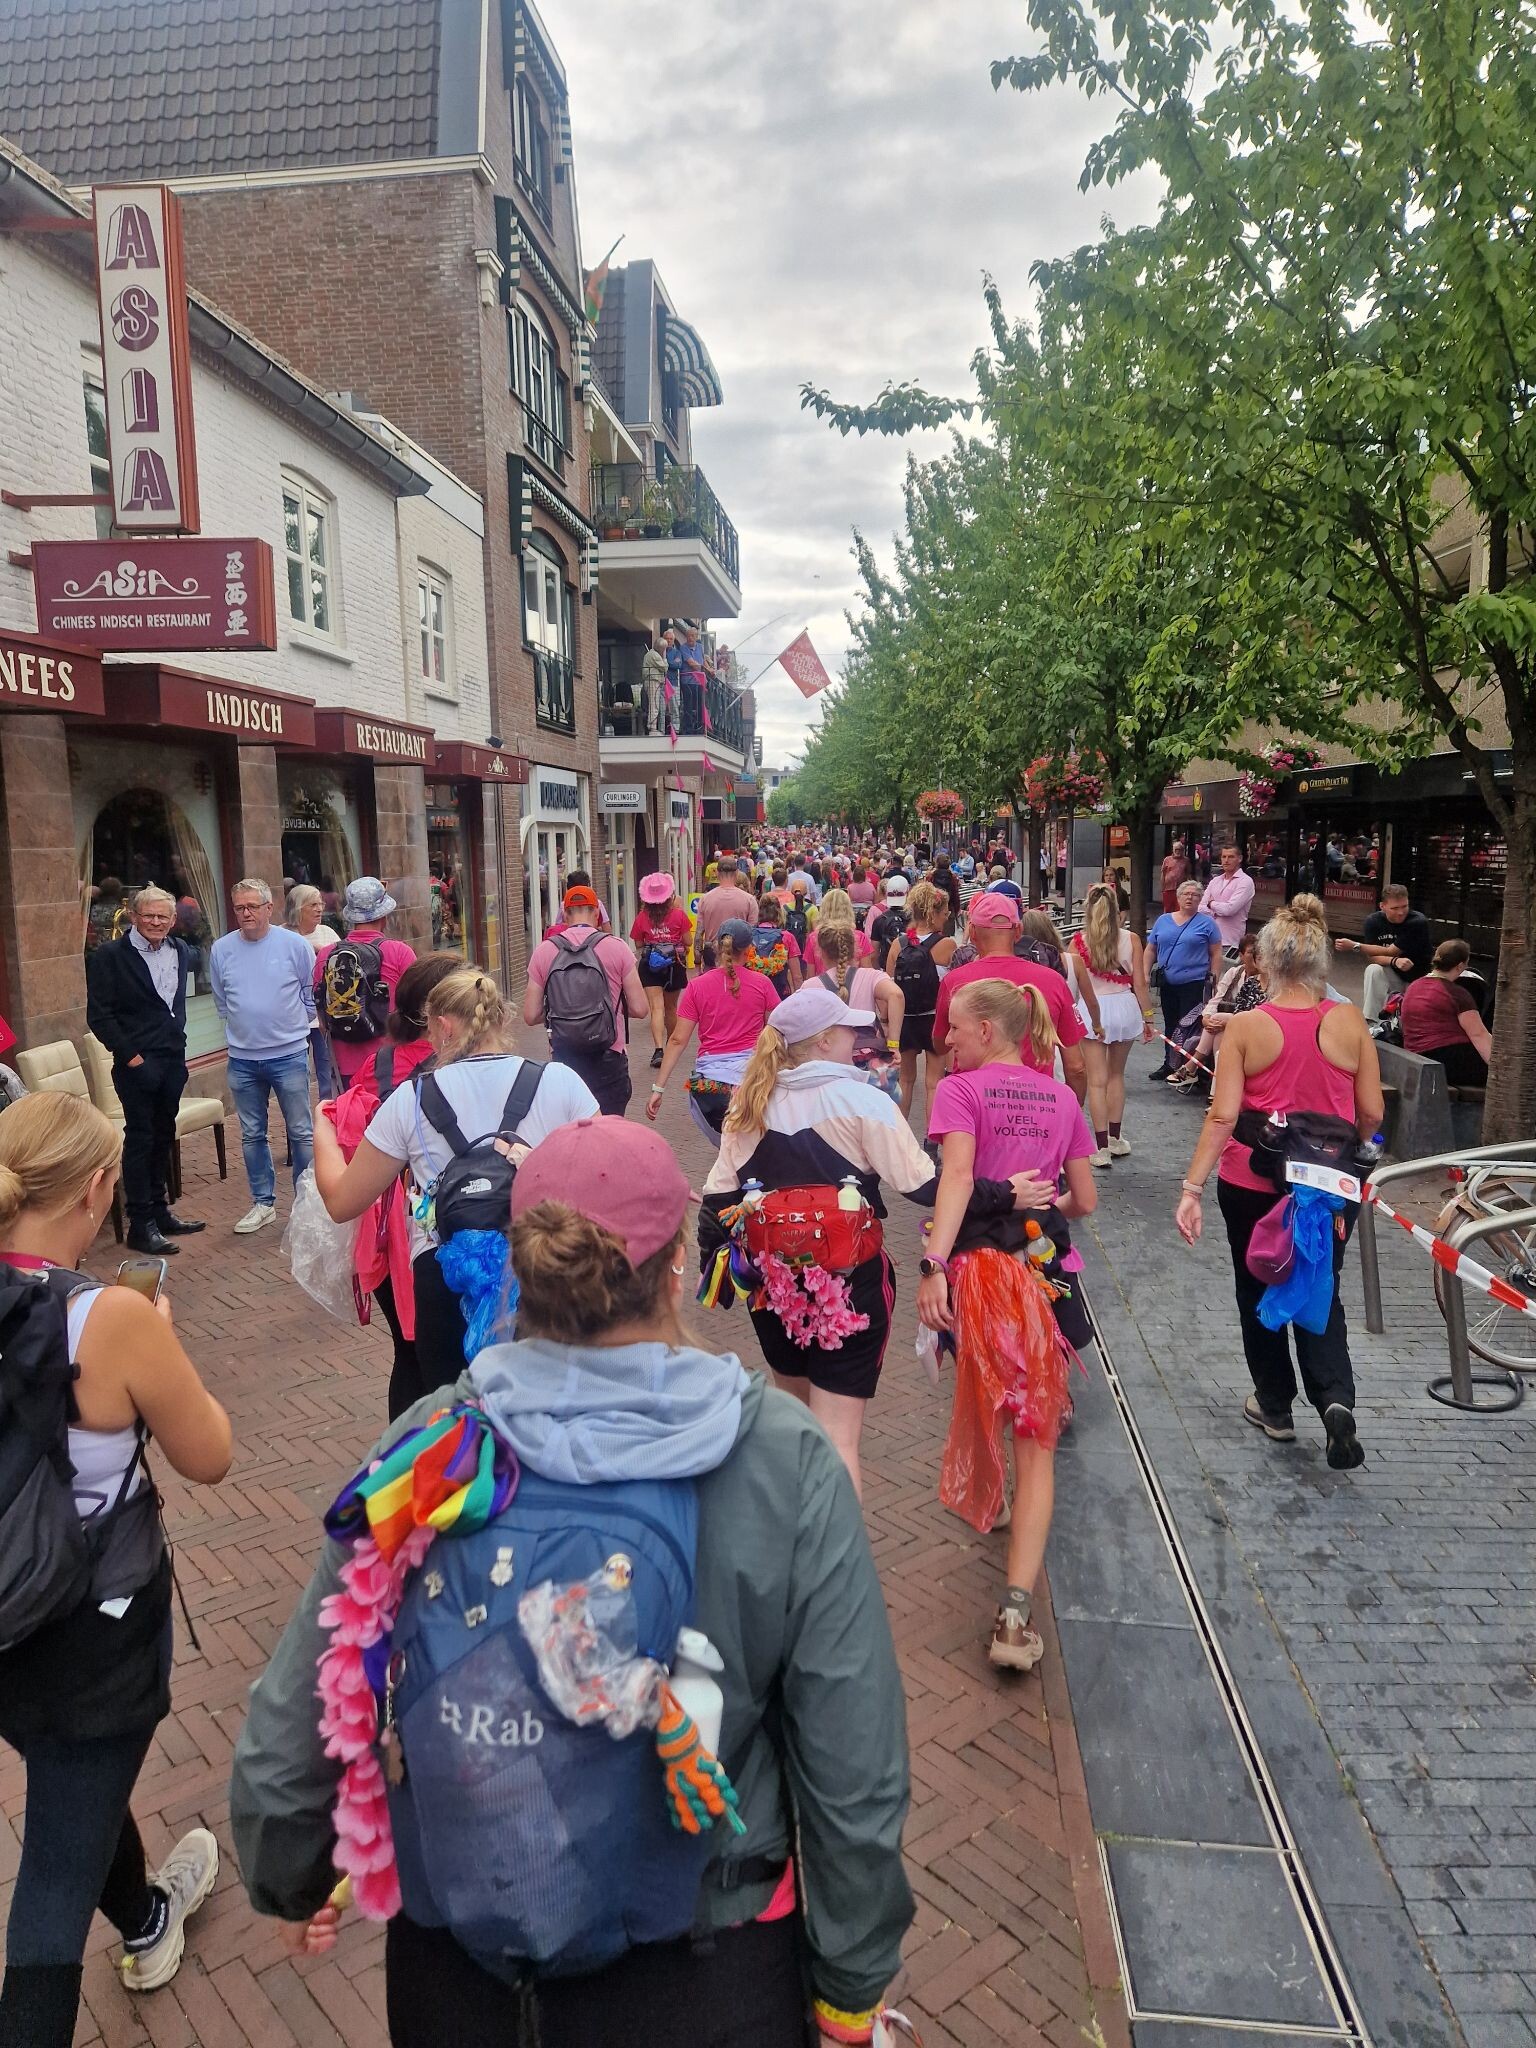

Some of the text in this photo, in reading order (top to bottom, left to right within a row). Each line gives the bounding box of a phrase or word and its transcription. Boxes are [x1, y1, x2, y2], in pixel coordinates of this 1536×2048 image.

[104, 203, 176, 512] ASIA
[52, 613, 212, 629] CHINEES INDISCH RESTAURANT
[0, 649, 76, 701] NEES
[206, 690, 283, 734] INDISCH
[356, 722, 427, 760] RESTAURANT
[606, 793, 637, 801] DURLINGER
[984, 1087, 1057, 1103] INSTAGRAM
[1007, 1102, 1024, 1111] heb
[1040, 1105, 1056, 1114] pas
[1006, 1114, 1038, 1126] VEEL
[993, 1126, 1049, 1139] VOLGERS
[464, 1704, 544, 1746] Rab
